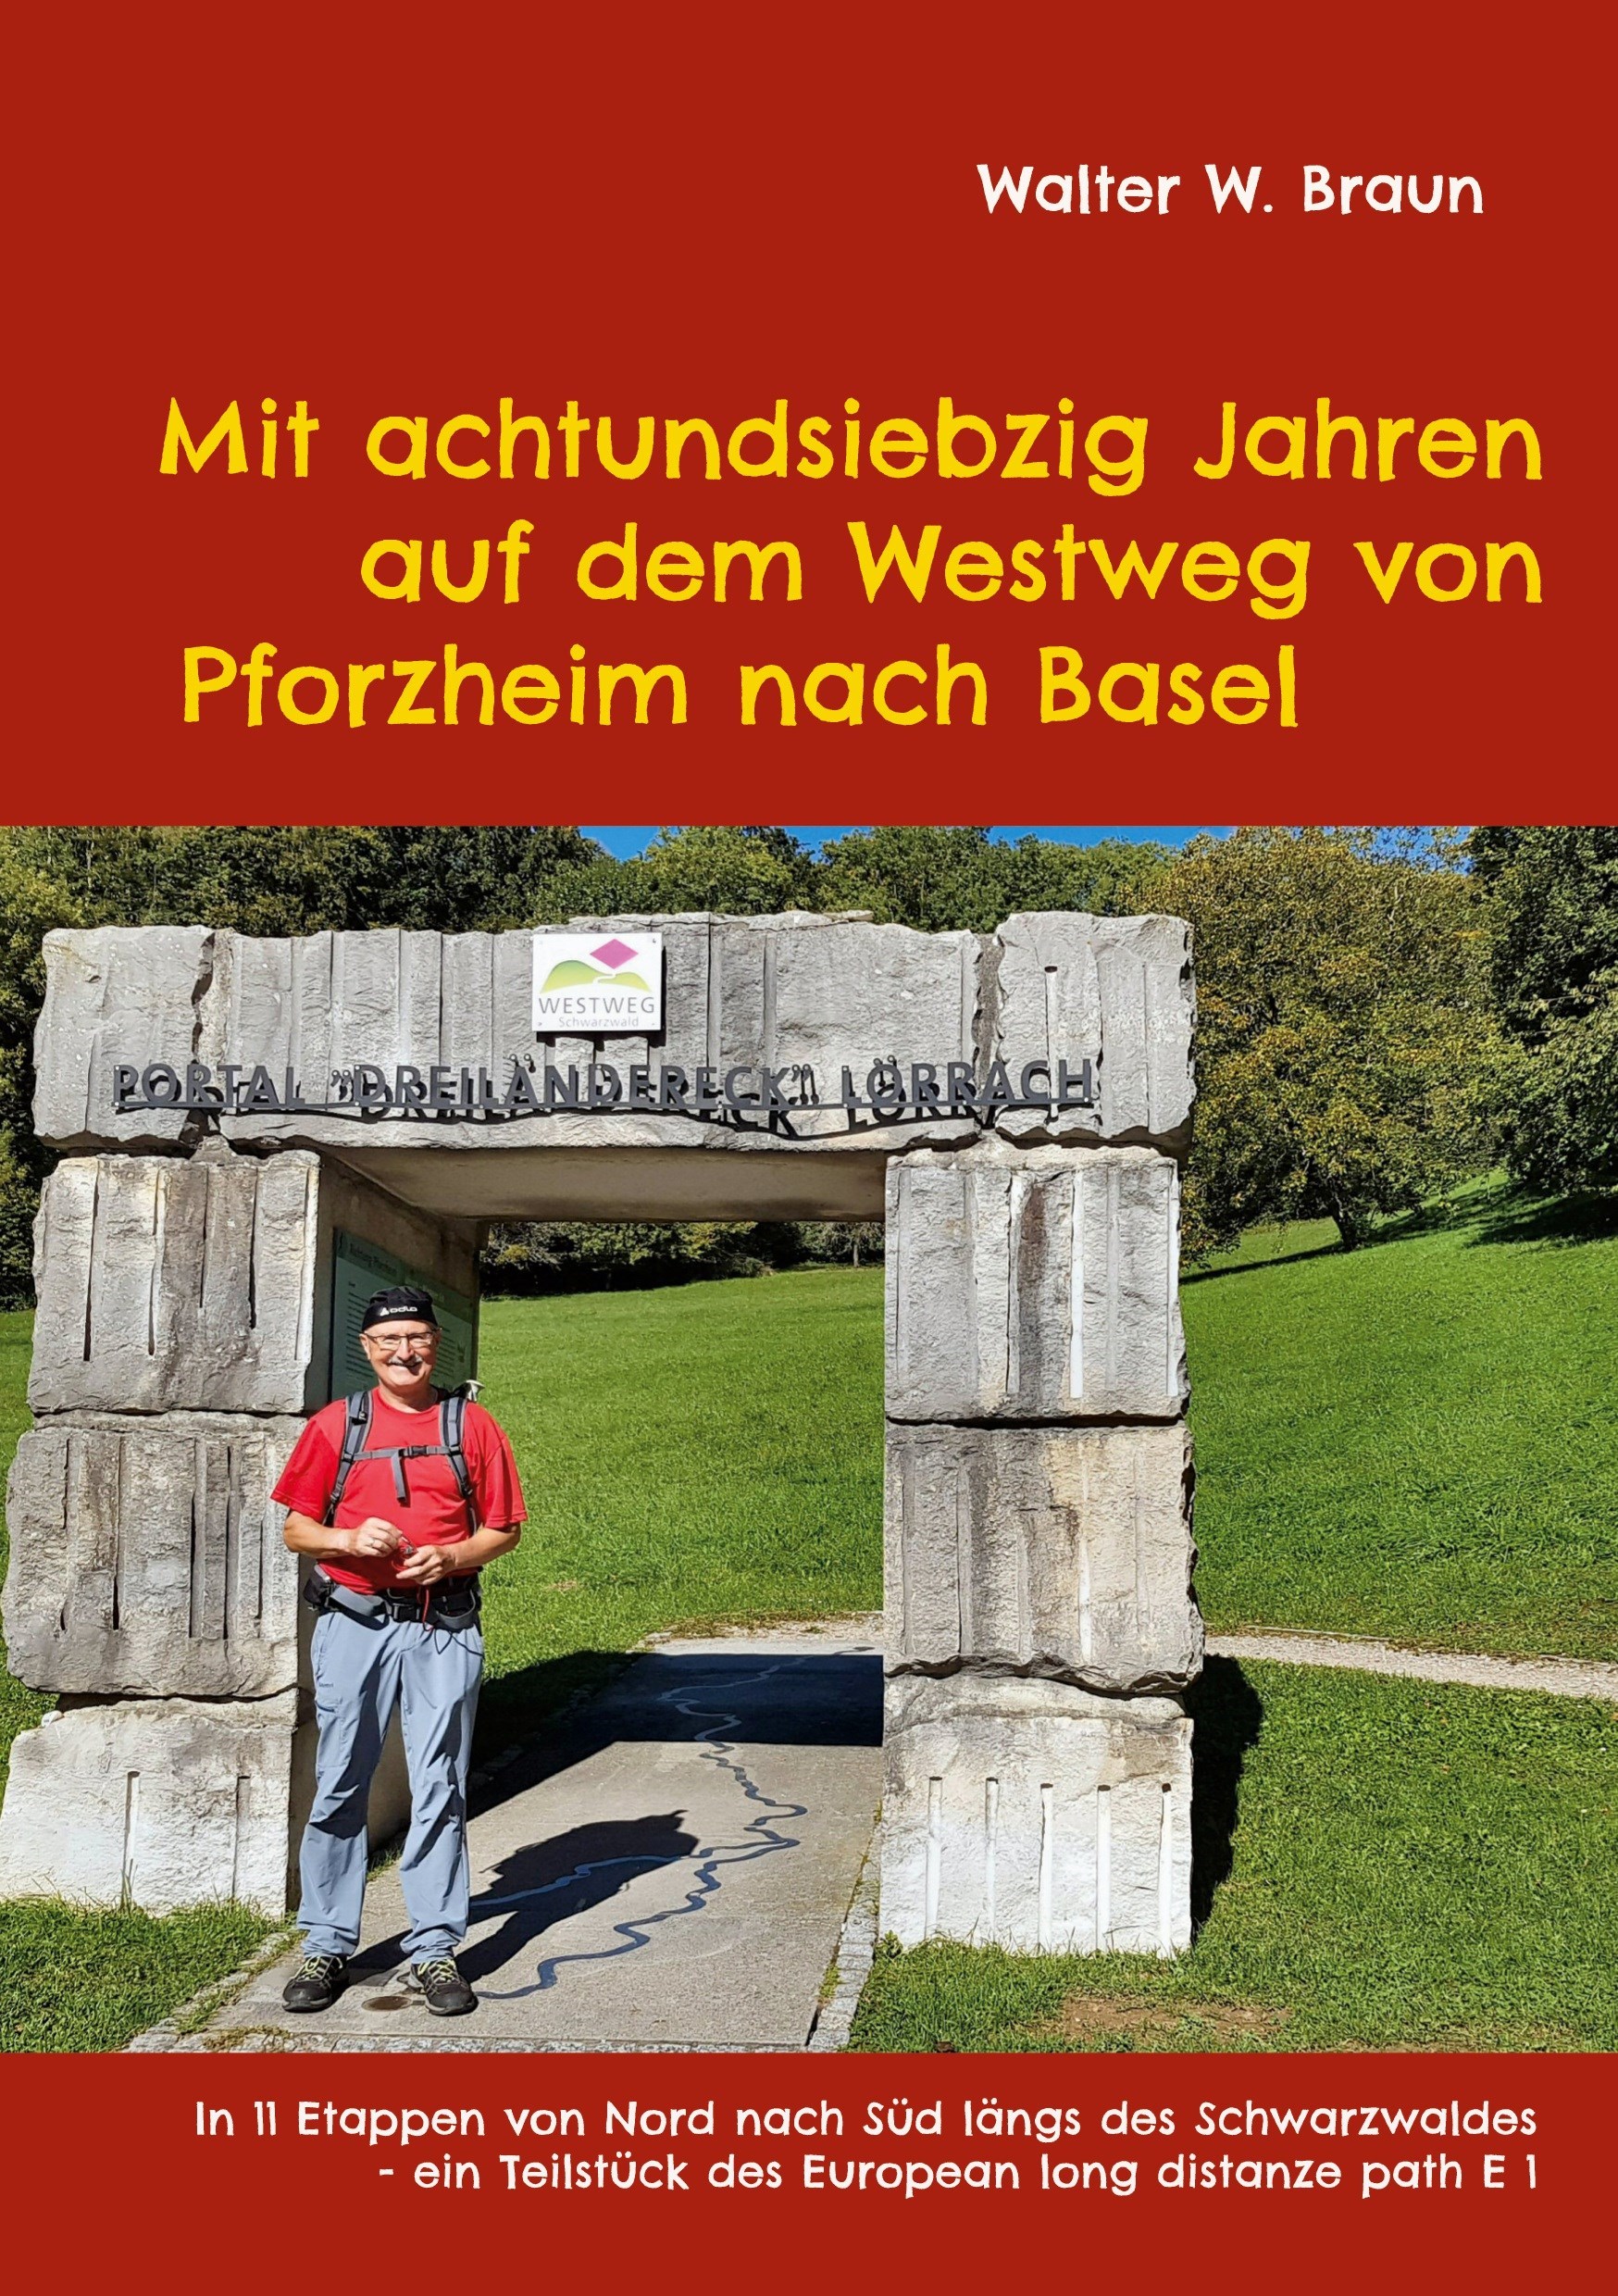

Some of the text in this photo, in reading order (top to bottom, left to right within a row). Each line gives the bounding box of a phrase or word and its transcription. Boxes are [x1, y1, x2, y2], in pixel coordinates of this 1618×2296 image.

[539, 996, 654, 1014] WESTWEG
[558, 1017, 639, 1028] Schwarzwald
[113, 1064, 305, 1107] PORTAL
[841, 1054, 1092, 1108] LÖRRACH
